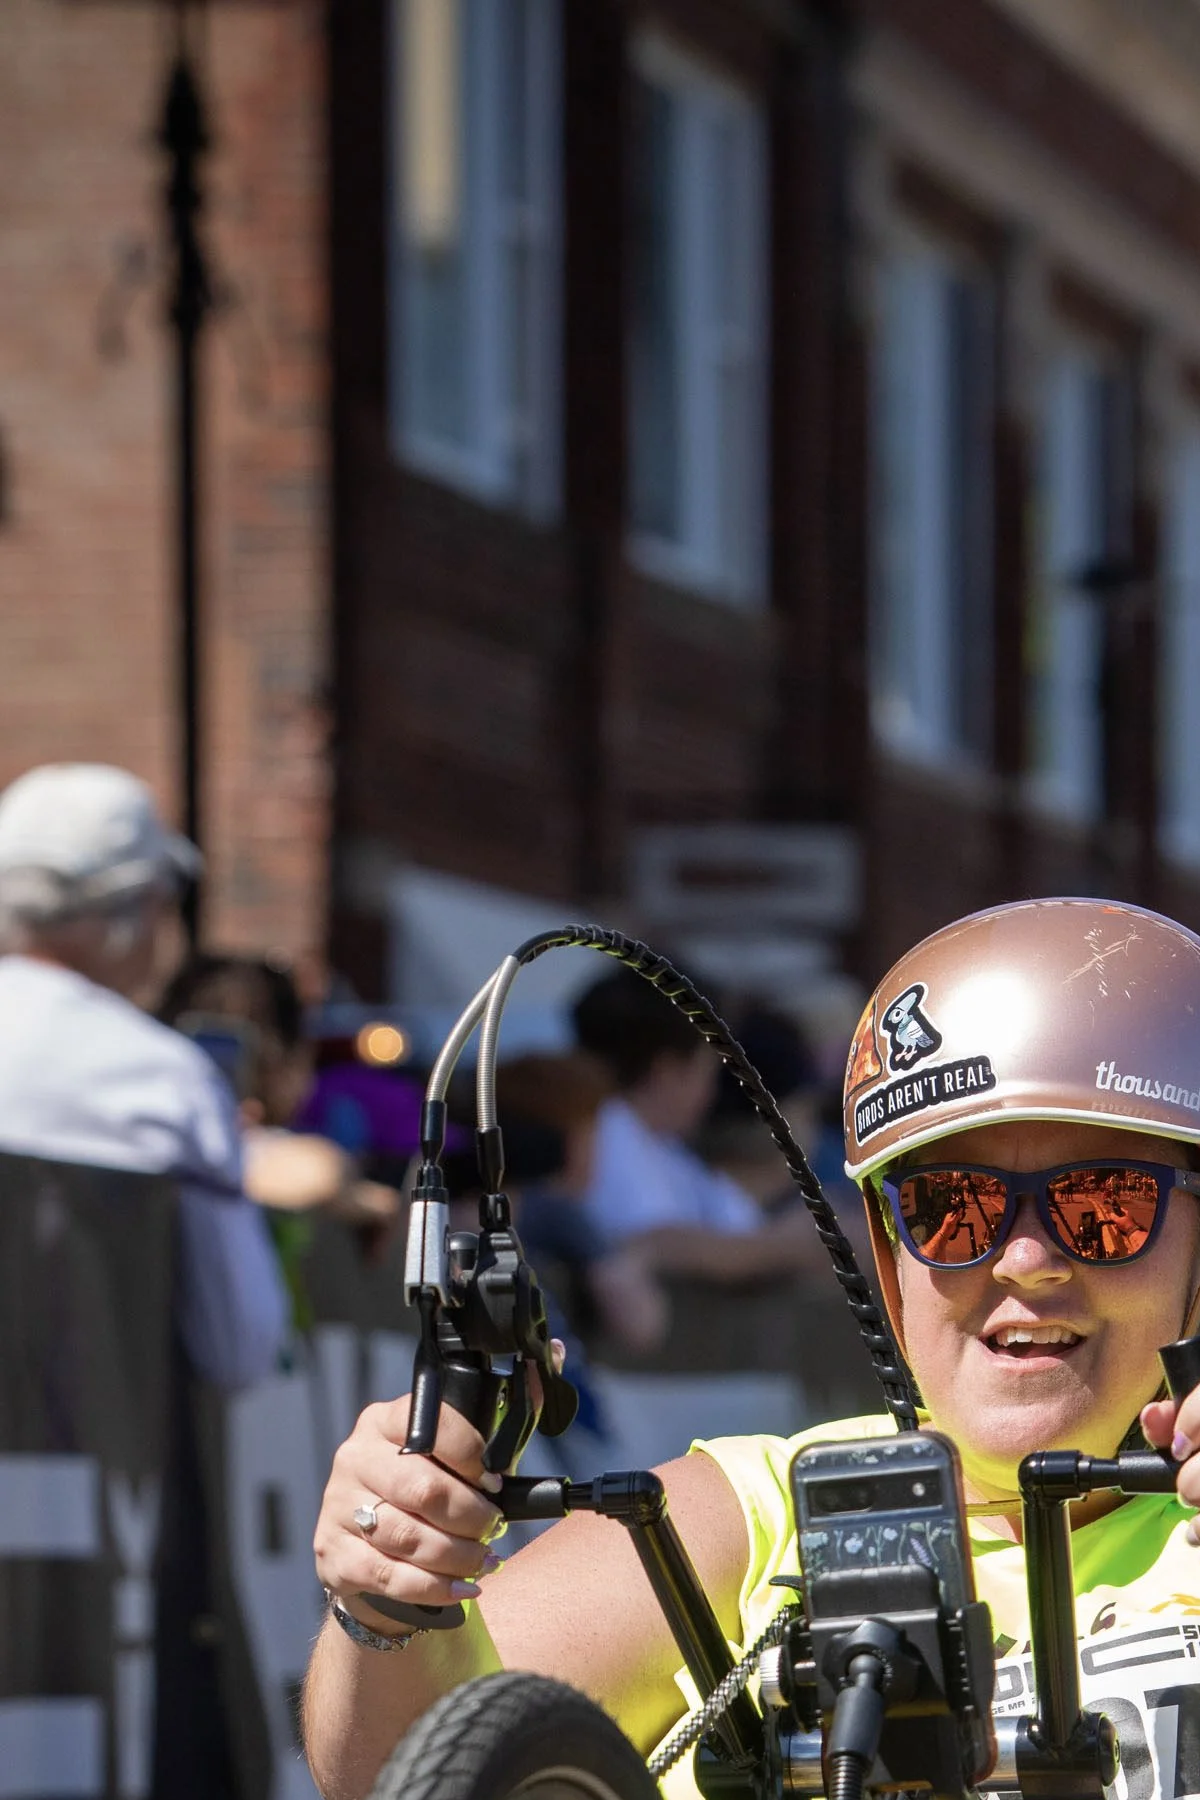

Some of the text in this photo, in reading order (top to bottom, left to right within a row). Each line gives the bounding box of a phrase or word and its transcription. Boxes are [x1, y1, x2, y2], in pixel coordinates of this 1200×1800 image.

[857, 1063, 989, 1134] BIRDS AREN'T REAL
